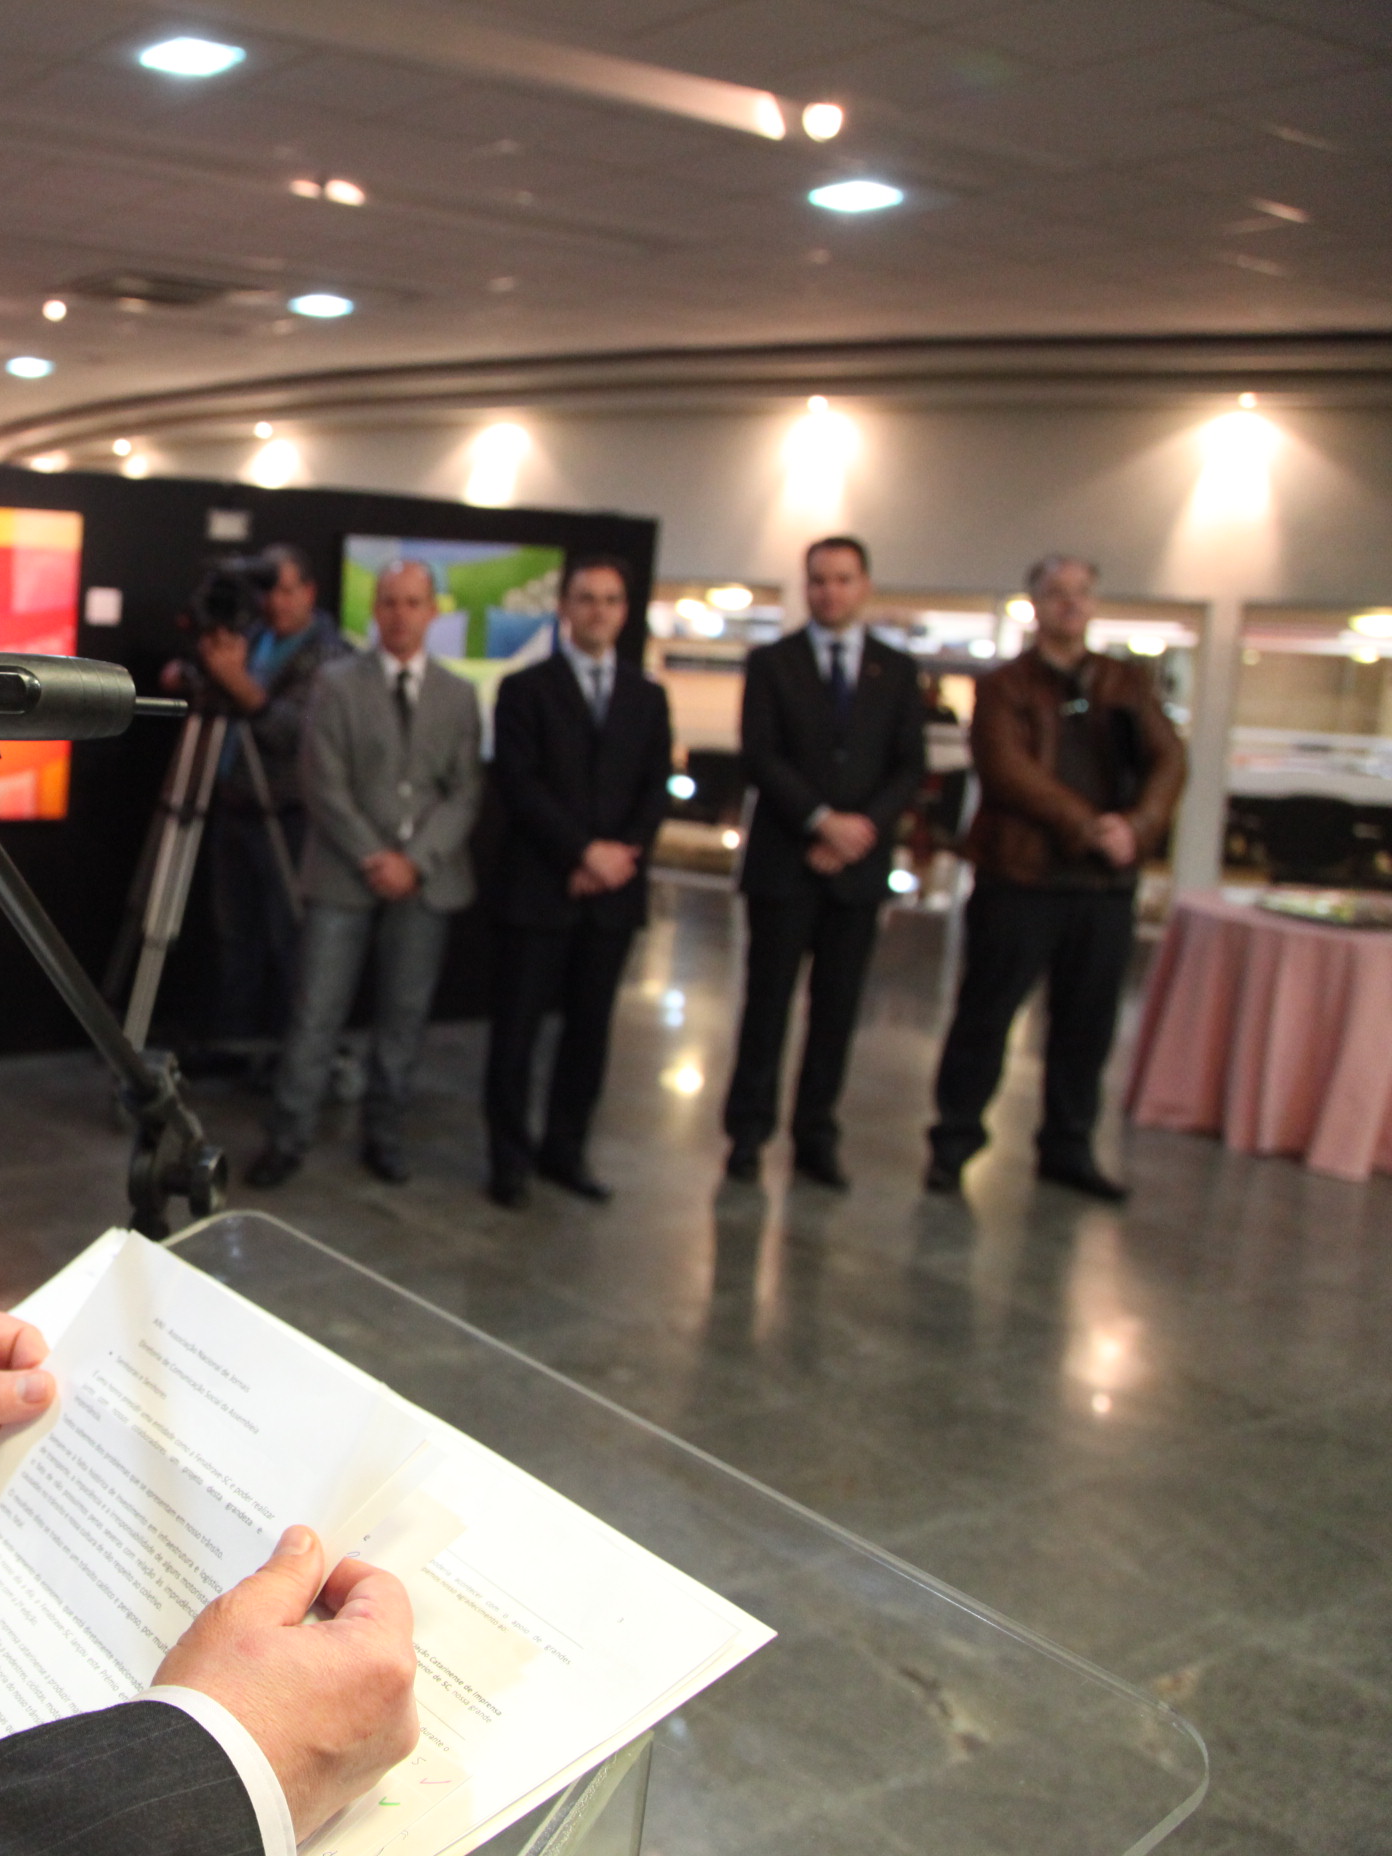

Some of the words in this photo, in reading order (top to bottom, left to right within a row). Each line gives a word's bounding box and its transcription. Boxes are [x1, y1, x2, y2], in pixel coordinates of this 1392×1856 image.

[183, 1522, 202, 1539] nosso
[224, 1501, 254, 1527] grandeza
[456, 1591, 499, 1626] agradecimento
[141, 1624, 154, 1639] por
[510, 1617, 530, 1635] apoio
[544, 1642, 571, 1666] grandes
[428, 1655, 464, 1687] Catarinense
[471, 1690, 502, 1717] Imprensa
[451, 1688, 470, 1706] nossa
[469, 1702, 492, 1724] grande
